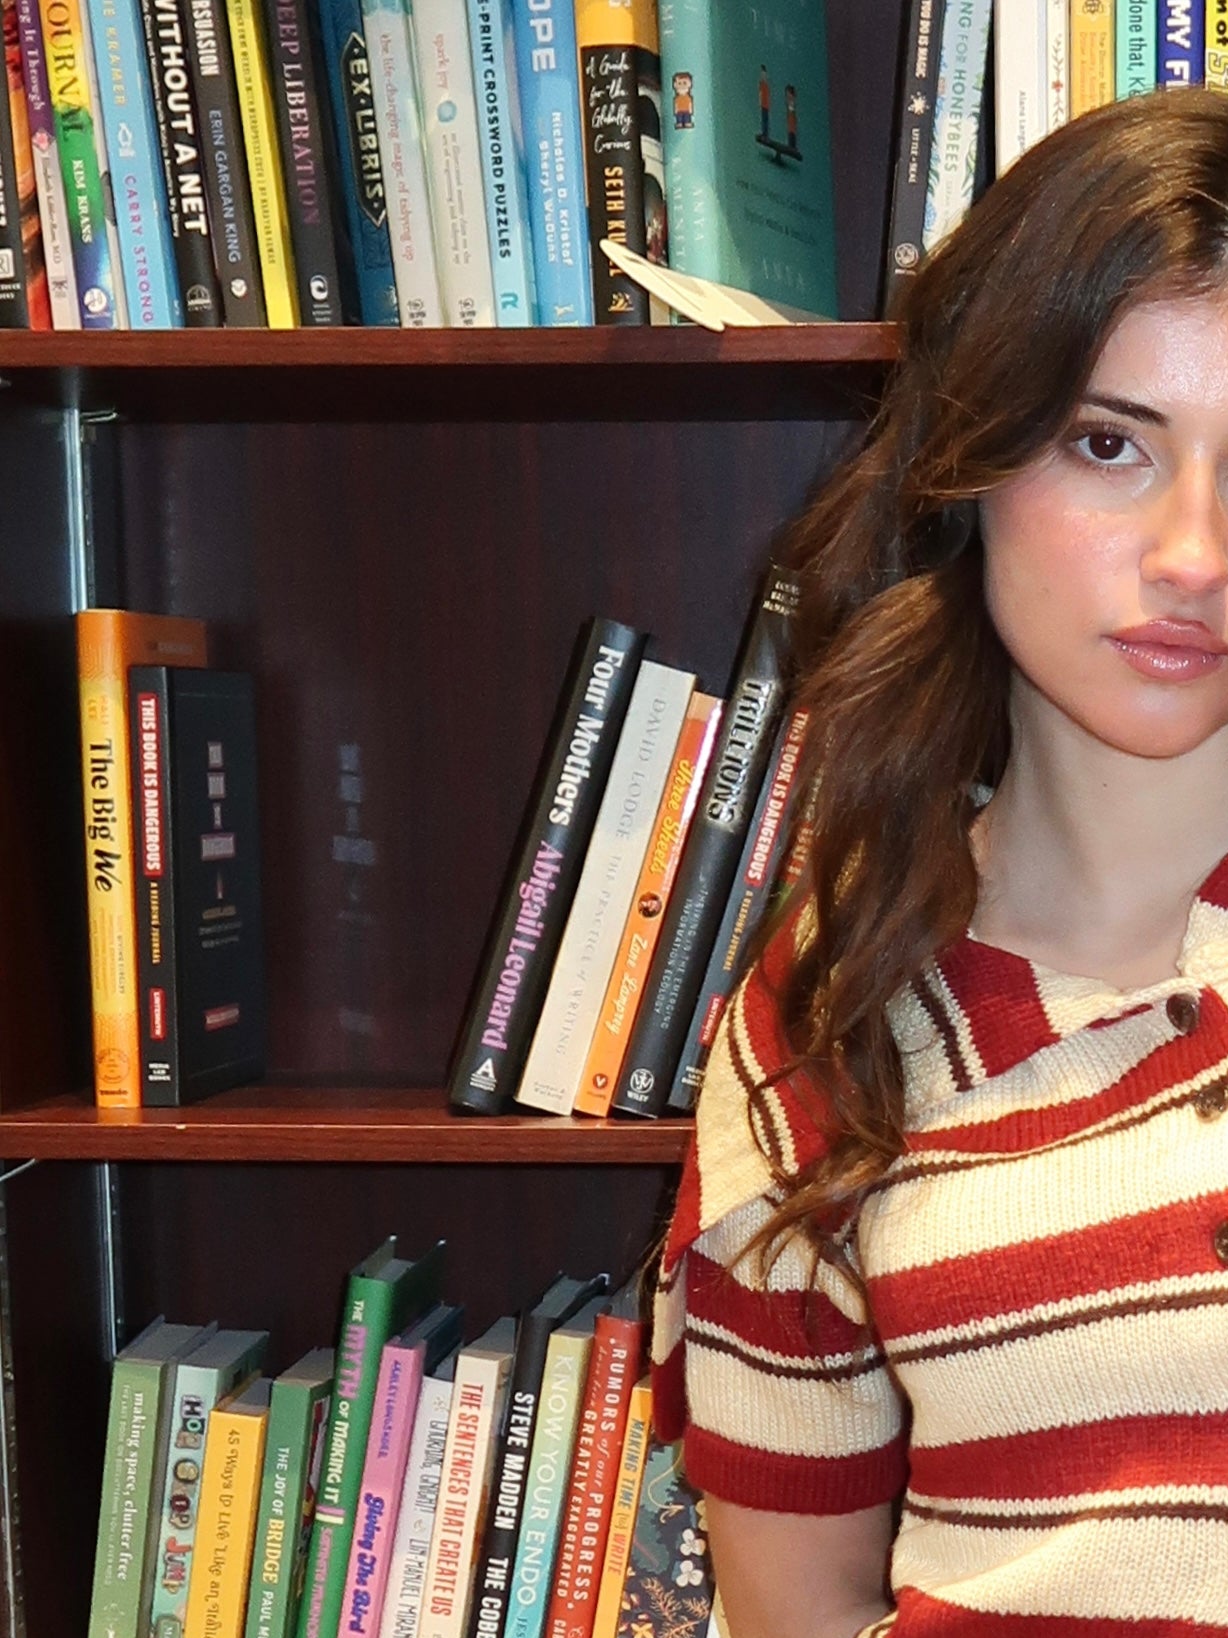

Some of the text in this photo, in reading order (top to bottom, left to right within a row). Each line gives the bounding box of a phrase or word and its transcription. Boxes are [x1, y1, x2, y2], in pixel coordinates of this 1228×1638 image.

[282, 62, 320, 225] LIBERATION
[392, 144, 405, 177] magic
[483, 70, 512, 259] CROSSWORD PUZZLES
[71, 160, 93, 243] KIM KRANS
[178, 173, 208, 236] NET
[208, 109, 243, 264] ERIN GARGAN KING
[398, 198, 413, 242] tidying
[605, 166, 625, 212] SETH
[125, 175, 154, 323] CARRY STRONG
[547, 643, 626, 827] Four Mothers
[87, 739, 114, 841] The Big
[479, 841, 564, 1052] Abigail Leonard
[508, 1390, 537, 1450] STEVE
[600, 1347, 627, 1432] RUMORS
[493, 1452, 526, 1530] MADDEN
[515, 1353, 575, 1607] KNOW YOUR ENDO
[262, 1517, 285, 1584] BRIDGE
